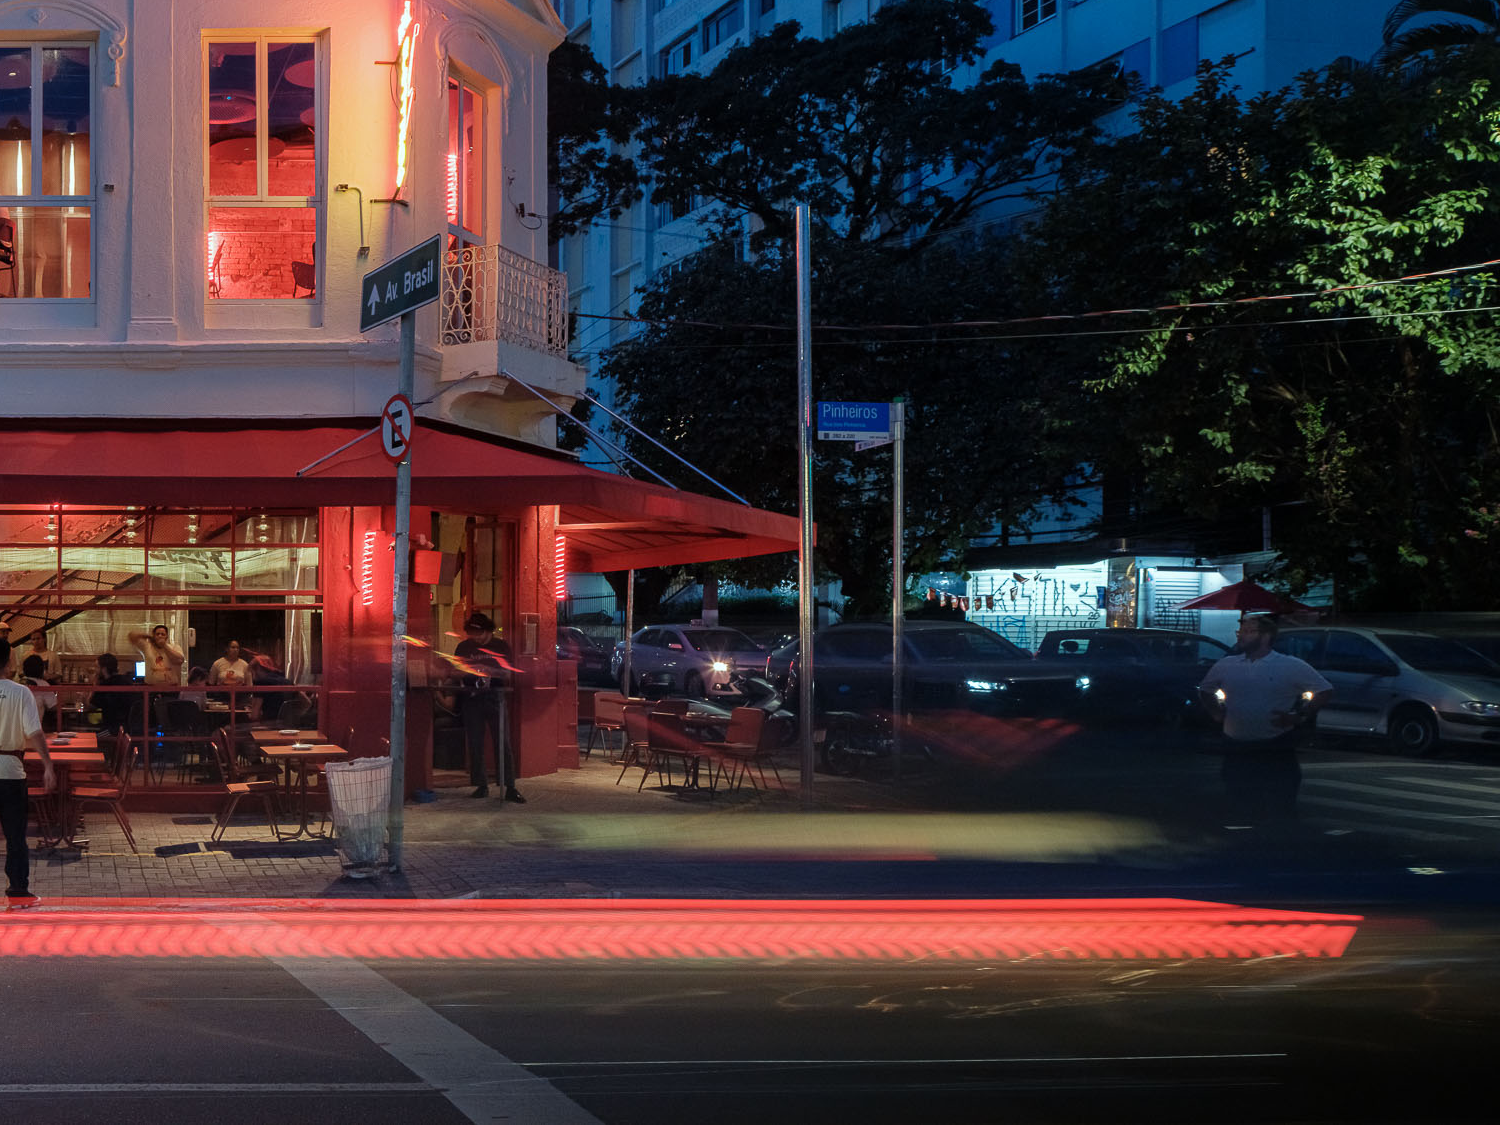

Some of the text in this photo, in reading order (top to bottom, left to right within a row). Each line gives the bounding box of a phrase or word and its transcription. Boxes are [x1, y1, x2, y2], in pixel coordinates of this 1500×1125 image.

[385, 259, 434, 304] Av. Brasil
[823, 403, 878, 419] Pinheiros
